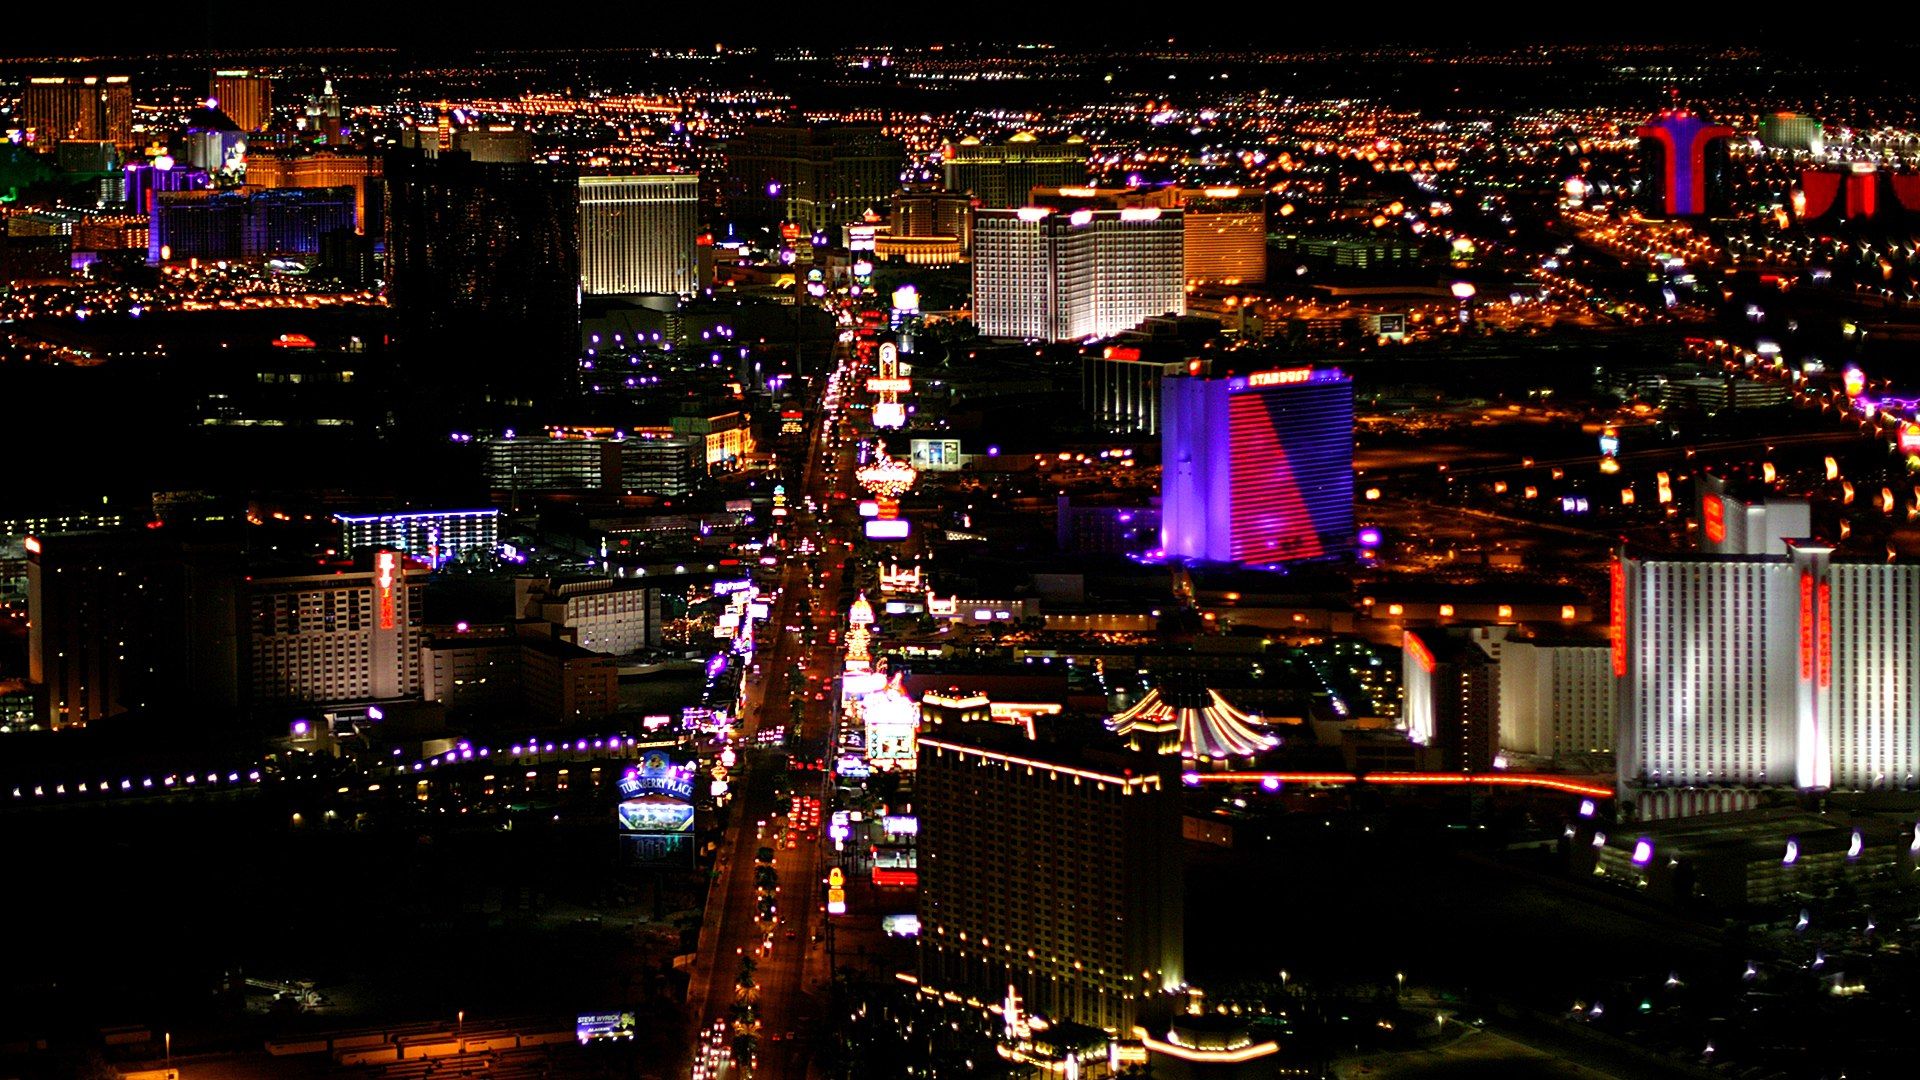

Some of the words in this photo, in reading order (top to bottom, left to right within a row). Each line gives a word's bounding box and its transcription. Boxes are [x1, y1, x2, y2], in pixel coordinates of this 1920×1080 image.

[1249, 369, 1310, 386] STARDUST
[620, 777, 668, 794] TURNBERRY
[667, 777, 694, 797] PLACE
[577, 1016, 596, 1024] STEVE
